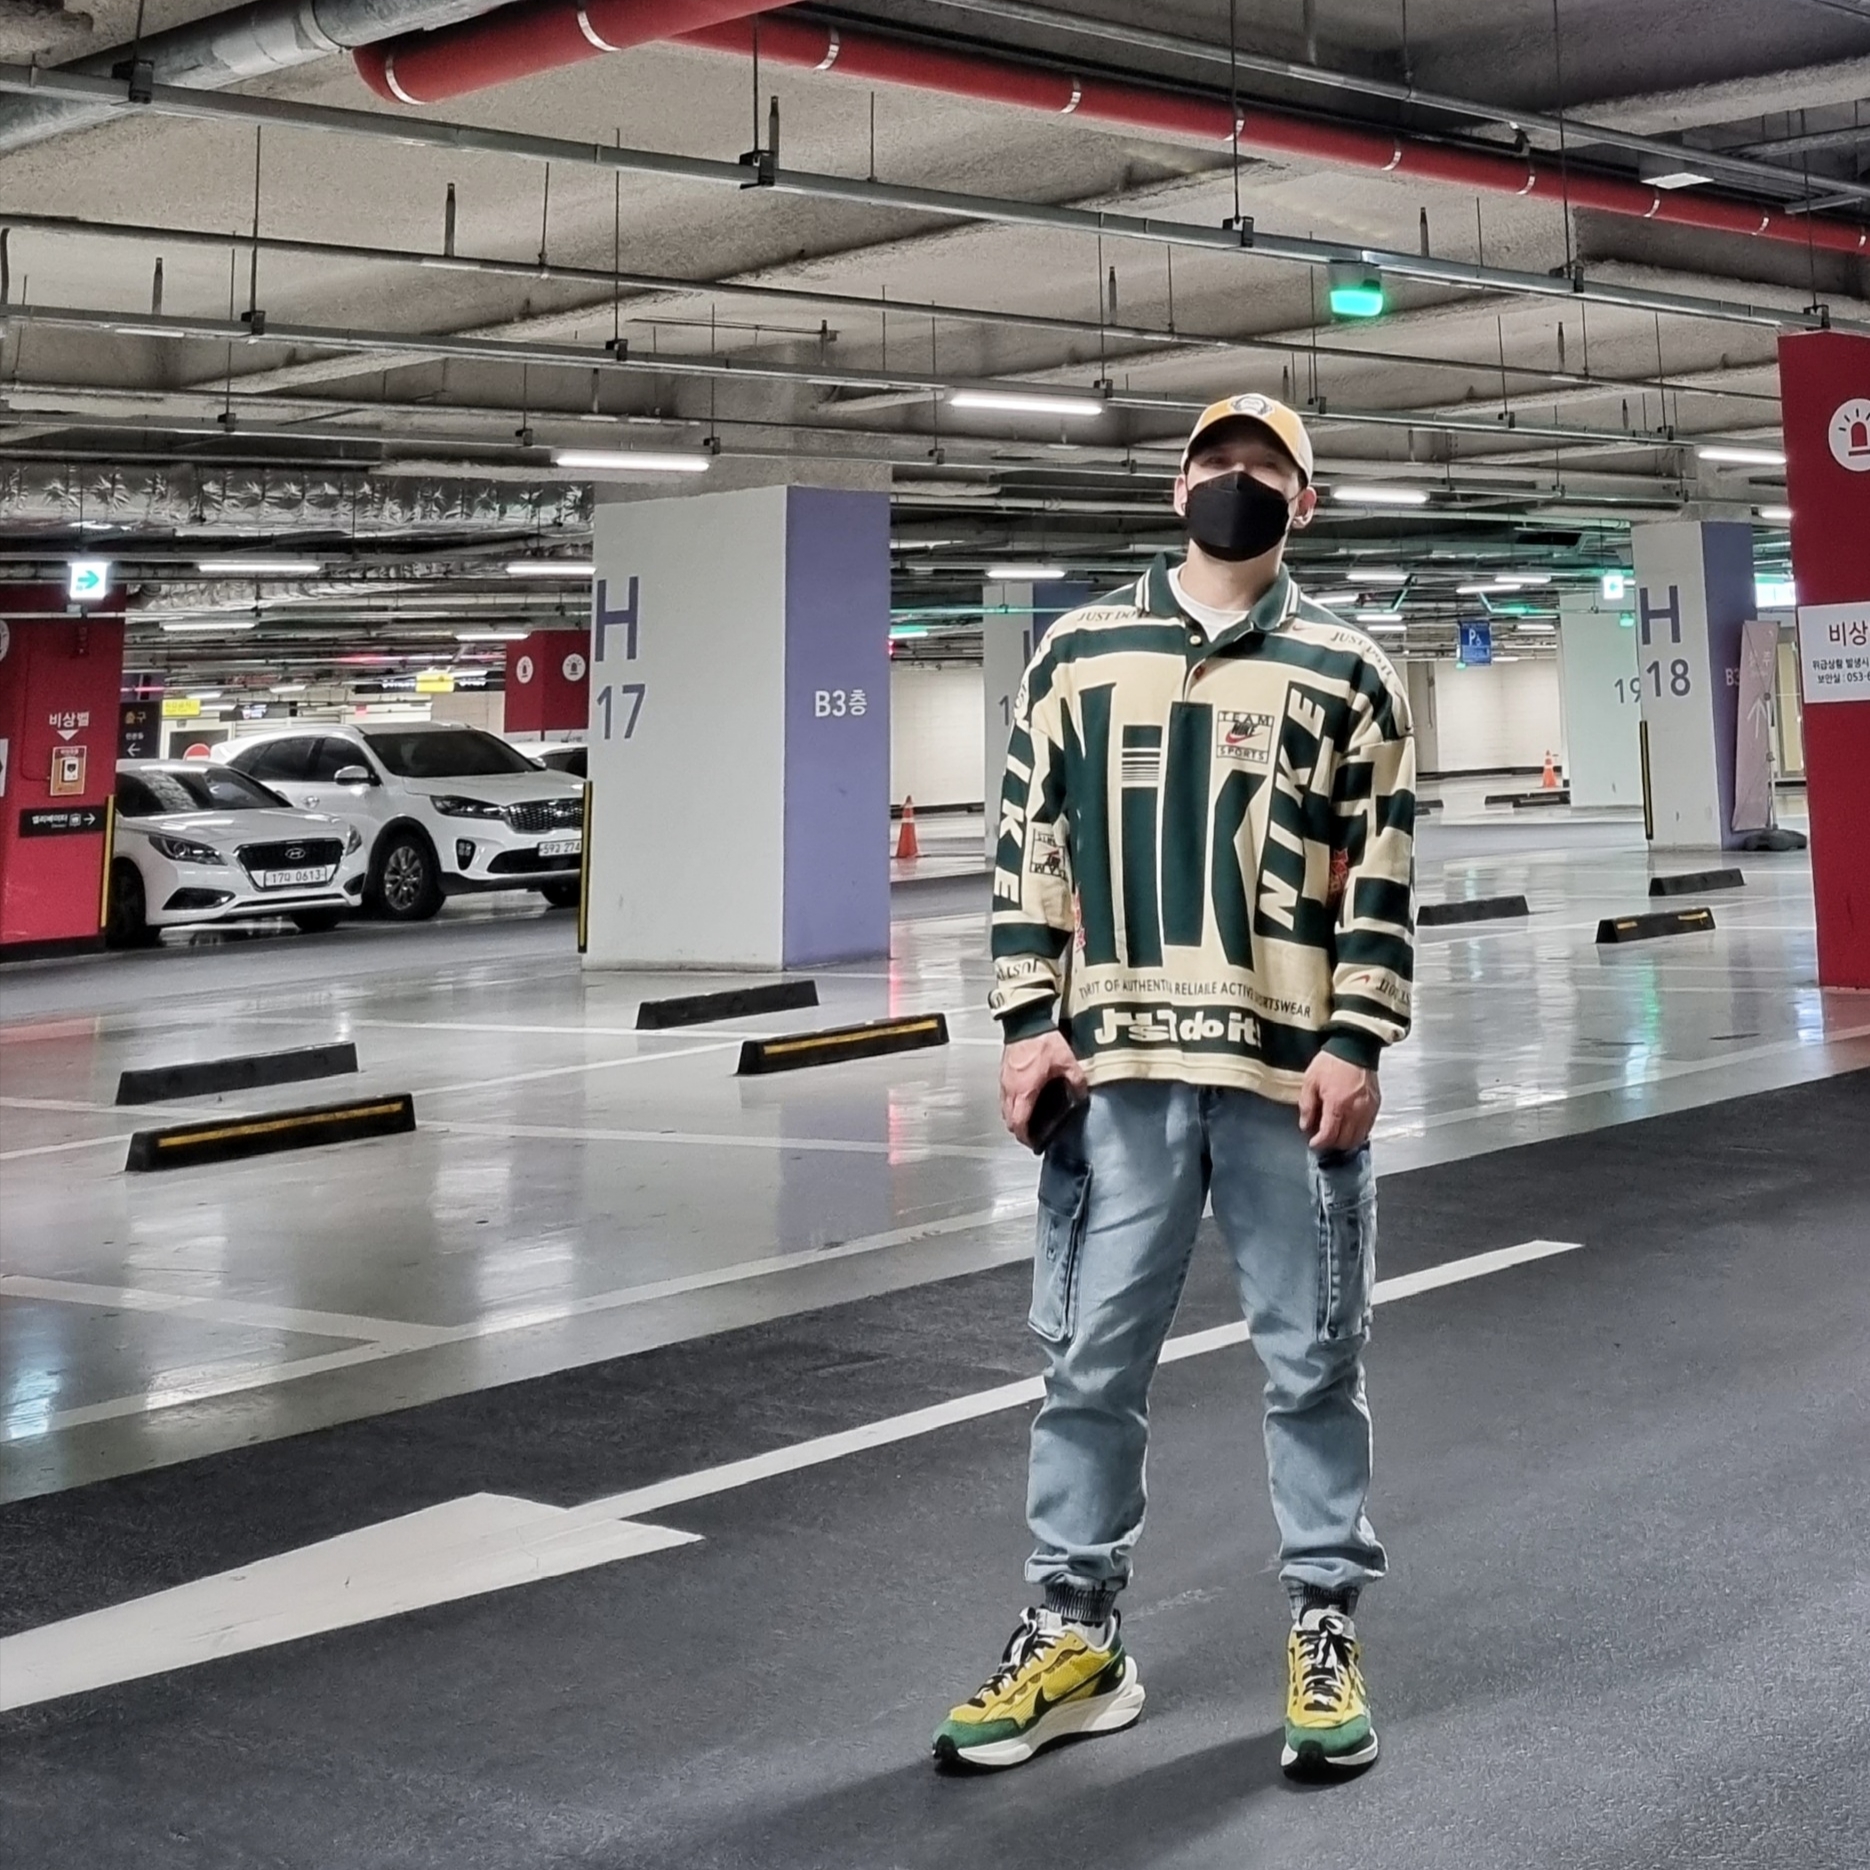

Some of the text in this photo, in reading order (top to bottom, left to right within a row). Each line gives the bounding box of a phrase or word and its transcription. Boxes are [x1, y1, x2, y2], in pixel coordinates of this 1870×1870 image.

[595, 576, 639, 662] H
[1640, 585, 1681, 645] H
[1646, 658, 1691, 697] 18
[596, 683, 646, 740] 17
[815, 689, 867, 717] B3층
[1219, 710, 1272, 727] TEAM
[1220, 746, 1265, 760] SPORTS
[296, 869, 321, 881] 0613
[1104, 979, 1120, 992] OF
[1179, 1011, 1224, 1041] do
